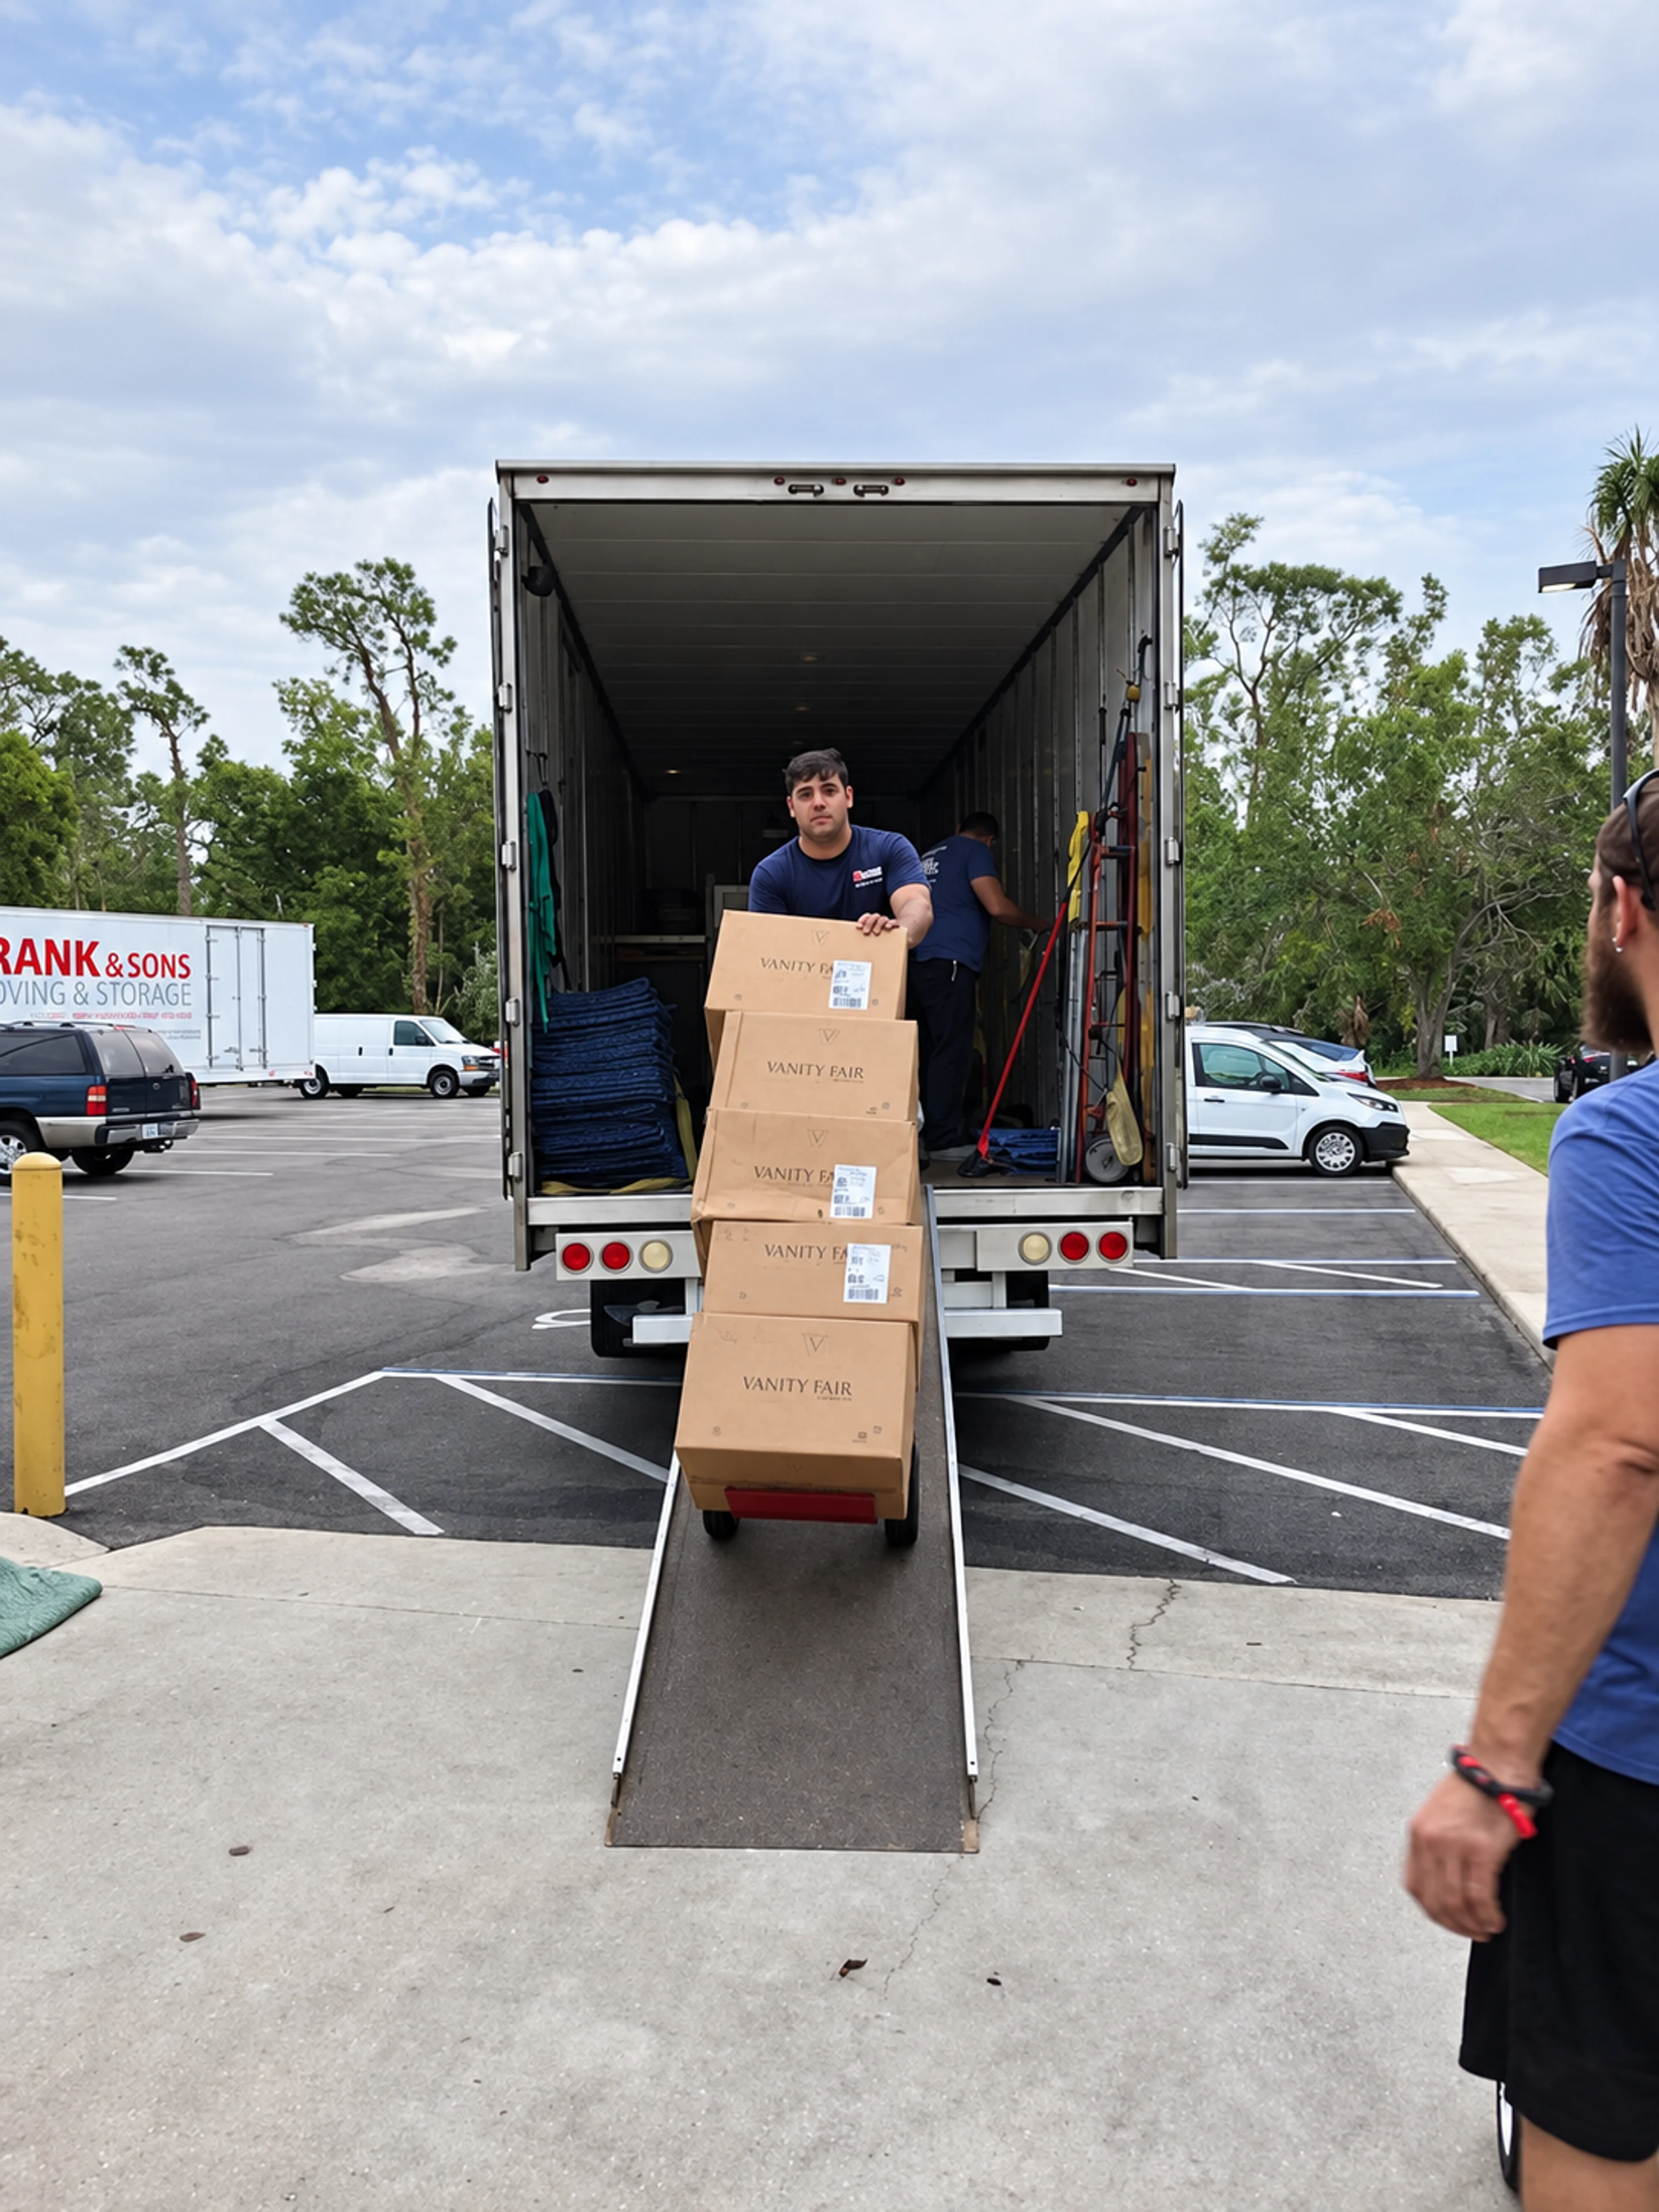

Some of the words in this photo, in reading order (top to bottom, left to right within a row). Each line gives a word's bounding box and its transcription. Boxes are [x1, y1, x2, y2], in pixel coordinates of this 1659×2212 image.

[0, 937, 100, 976] RANK
[105, 952, 123, 978] &
[127, 953, 191, 979] SONS
[760, 957, 815, 972] VANITY
[820, 963, 834, 974] FA
[73, 981, 89, 1006] &
[97, 982, 191, 1006] STORAGE
[767, 1061, 825, 1076] VANITY
[830, 1066, 863, 1079] FAIR
[754, 1165, 815, 1182] VANITY
[819, 1169, 834, 1183] FA
[764, 1244, 827, 1259] VANITY
[832, 1246, 848, 1260] FA
[743, 1376, 809, 1393] VANITY
[813, 1380, 852, 1395] FAIR
